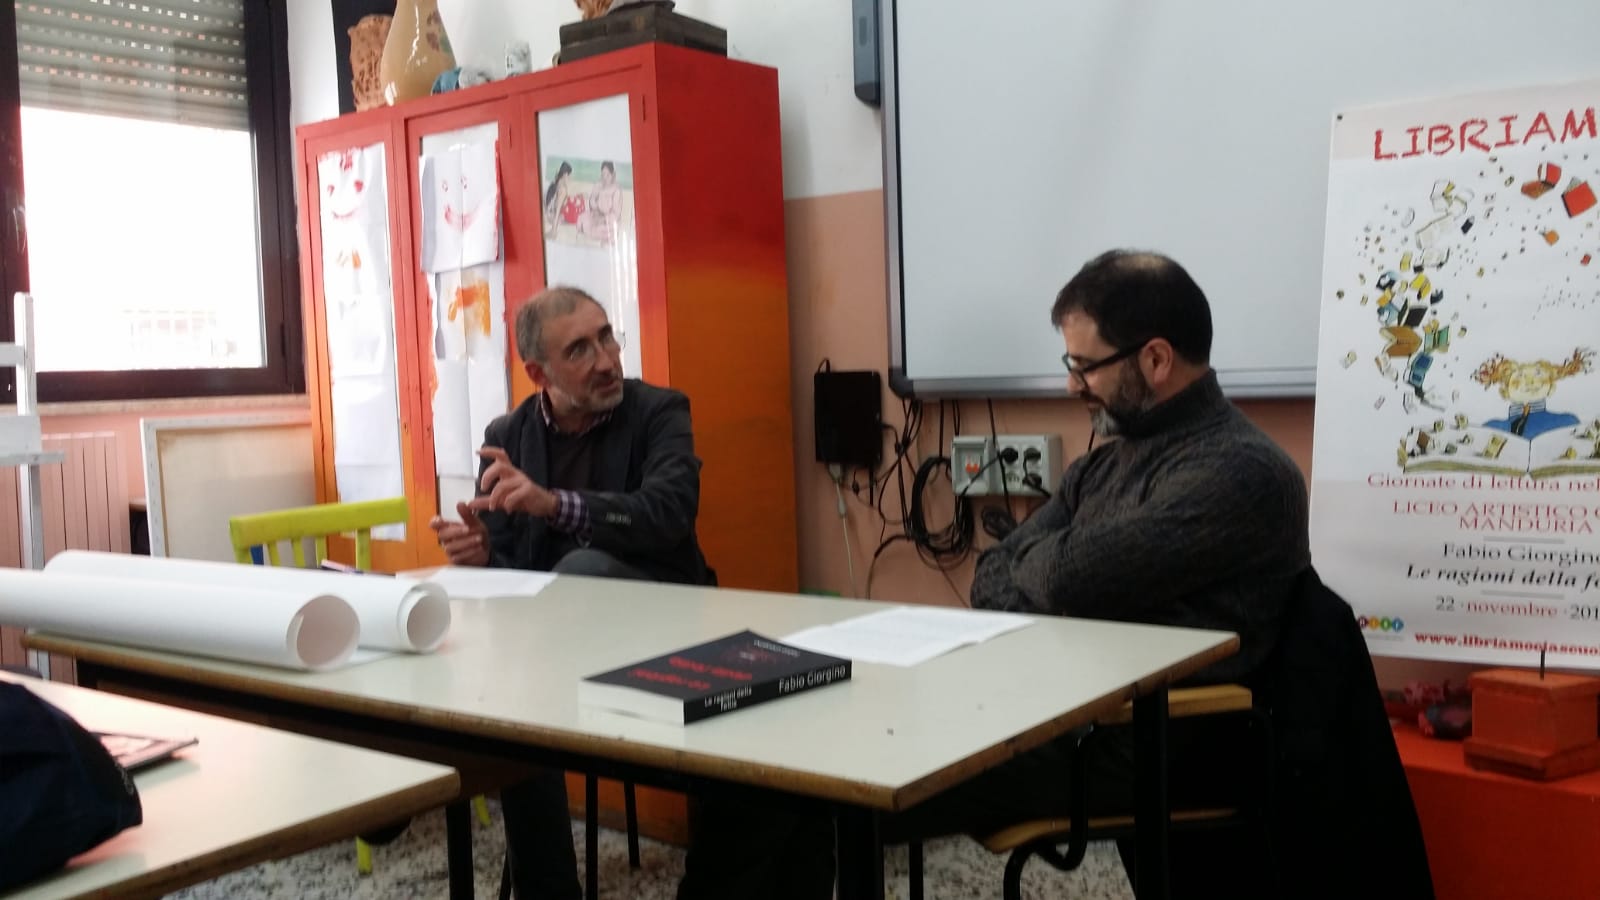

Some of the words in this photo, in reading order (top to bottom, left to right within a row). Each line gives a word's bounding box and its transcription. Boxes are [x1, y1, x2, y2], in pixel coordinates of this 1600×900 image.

[1374, 106, 1598, 160] LIBRIAM
[1367, 473, 1457, 489] Giornate
[1462, 474, 1482, 489] di
[1490, 475, 1560, 491] lettura
[1393, 500, 1459, 515] LICEO
[1464, 502, 1588, 520] ARTISTICO
[1459, 516, 1593, 534] MANDURIA
[1443, 543, 1501, 559] Fabio
[1407, 564, 1431, 579] Le
[1437, 567, 1515, 586] ragioni
[1521, 569, 1577, 588] della
[1435, 595, 1455, 612] 22
[1466, 602, 1558, 617] novembre
[778, 674, 805, 694] Fabio
[807, 665, 846, 684] Giorgino
